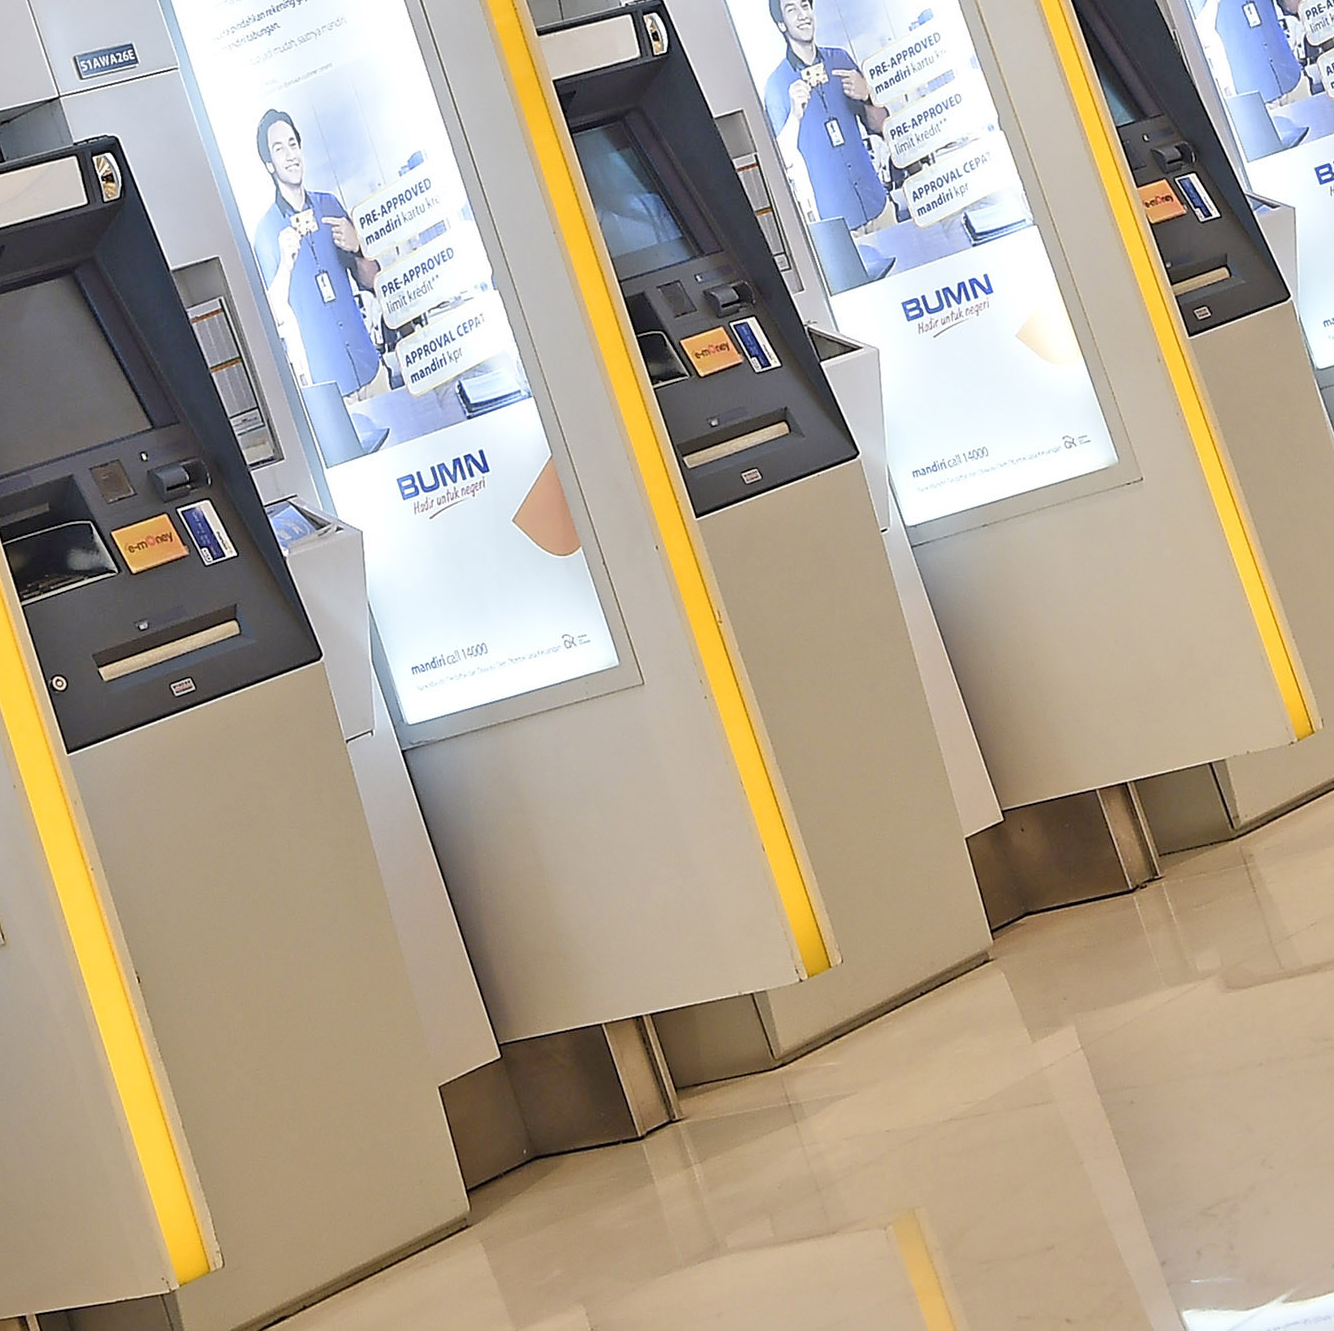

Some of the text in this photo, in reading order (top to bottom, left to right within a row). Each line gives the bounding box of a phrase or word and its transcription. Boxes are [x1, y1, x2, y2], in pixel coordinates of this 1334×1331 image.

[1310, 16, 1330, 34] limit
[869, 31, 942, 80] PRE-APPROVED
[874, 65, 912, 95] mandiri
[889, 92, 963, 140] PRE-APPROVED
[894, 137, 916, 156] limit
[911, 150, 992, 203] APPROVAL CEPAT
[359, 177, 432, 231] PRE-APPROVED
[917, 189, 954, 217] mandiri
[365, 202, 427, 246] mandiri kartu
[381, 246, 455, 298] PRE-APPROVED
[385, 293, 407, 315] limit
[901, 273, 994, 322] BUMN
[405, 312, 485, 368] APPROVAL CEPAT
[917, 317, 939, 335] Hadir
[410, 355, 448, 385] mandiri
[396, 449, 490, 501] BUMN
[912, 460, 948, 479] mandiri
[411, 655, 447, 675] mandiri
